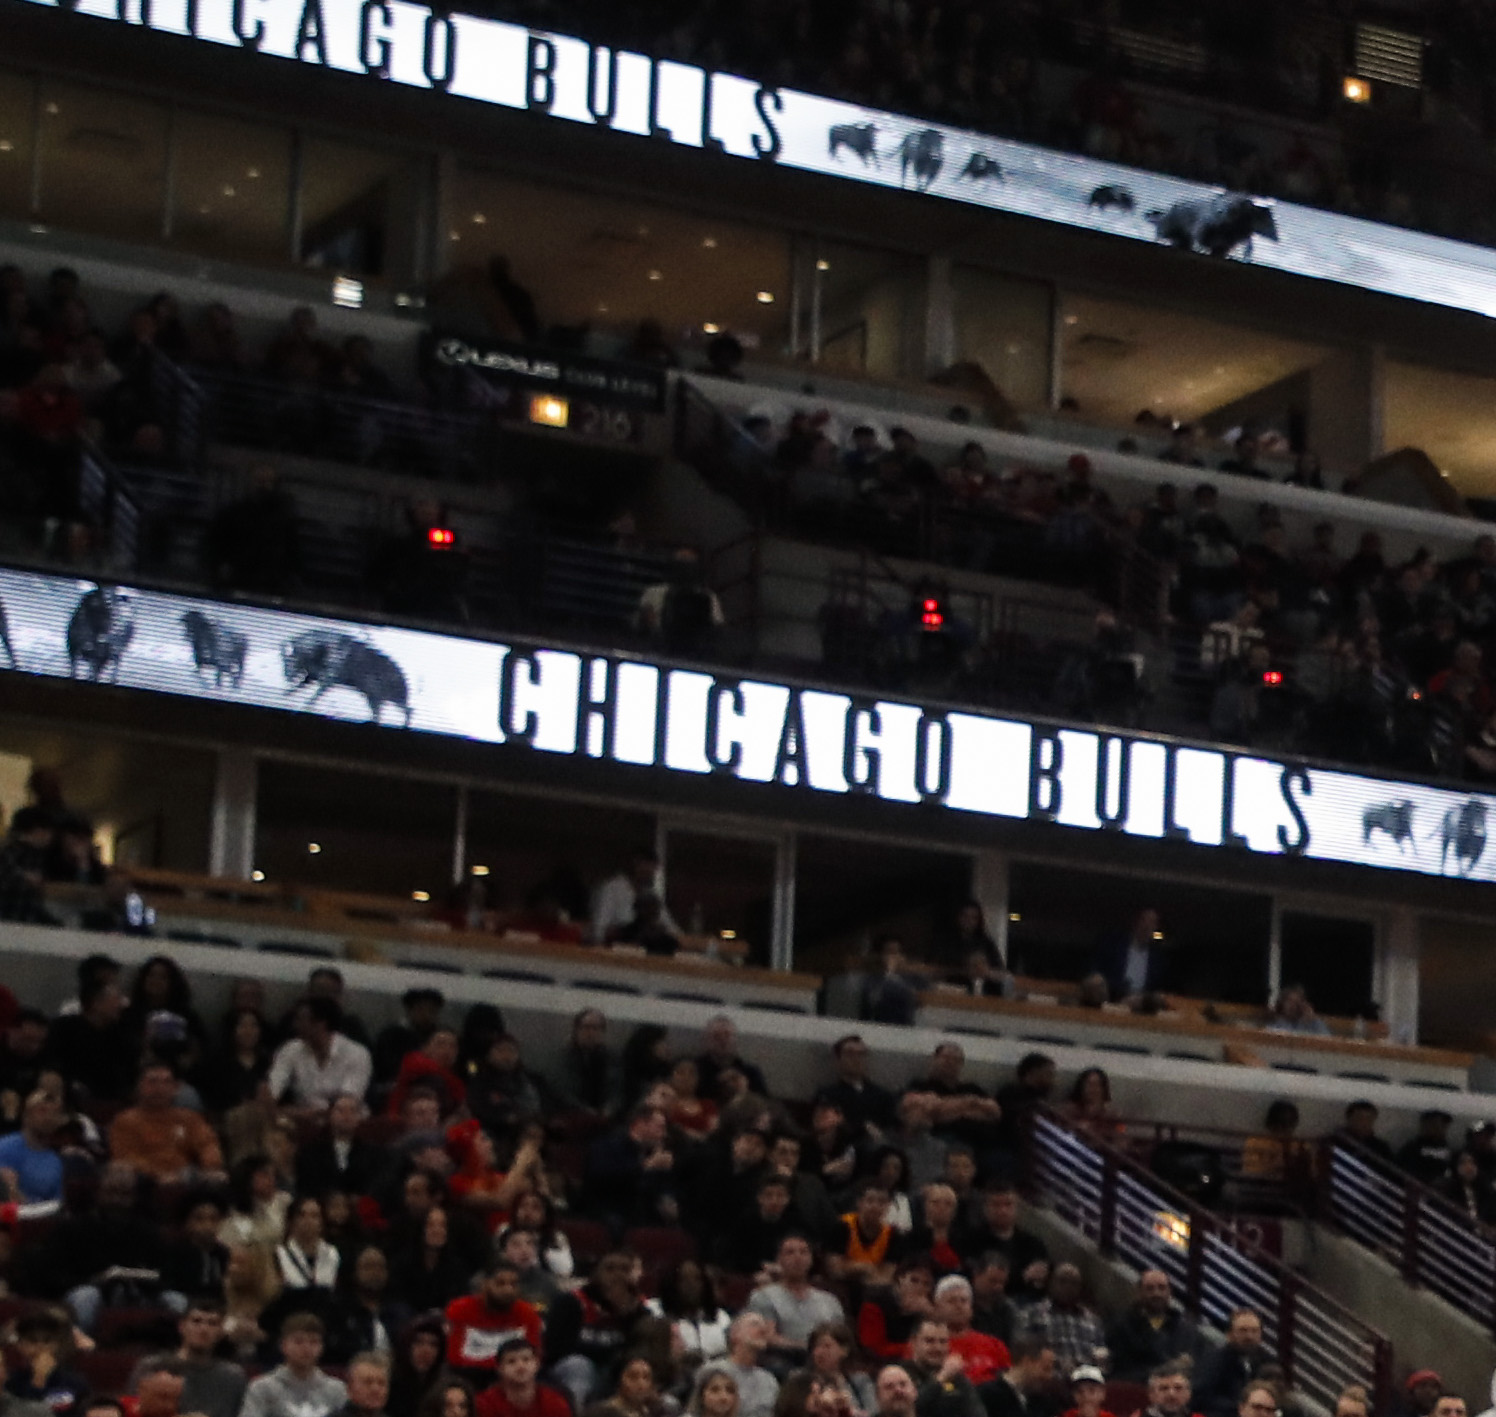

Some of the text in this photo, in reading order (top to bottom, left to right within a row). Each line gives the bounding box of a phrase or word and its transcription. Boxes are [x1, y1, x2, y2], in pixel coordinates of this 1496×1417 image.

[56, 0, 784, 162] CAGO BULLS
[499, 645, 1311, 856] CHICAGO BULLS
